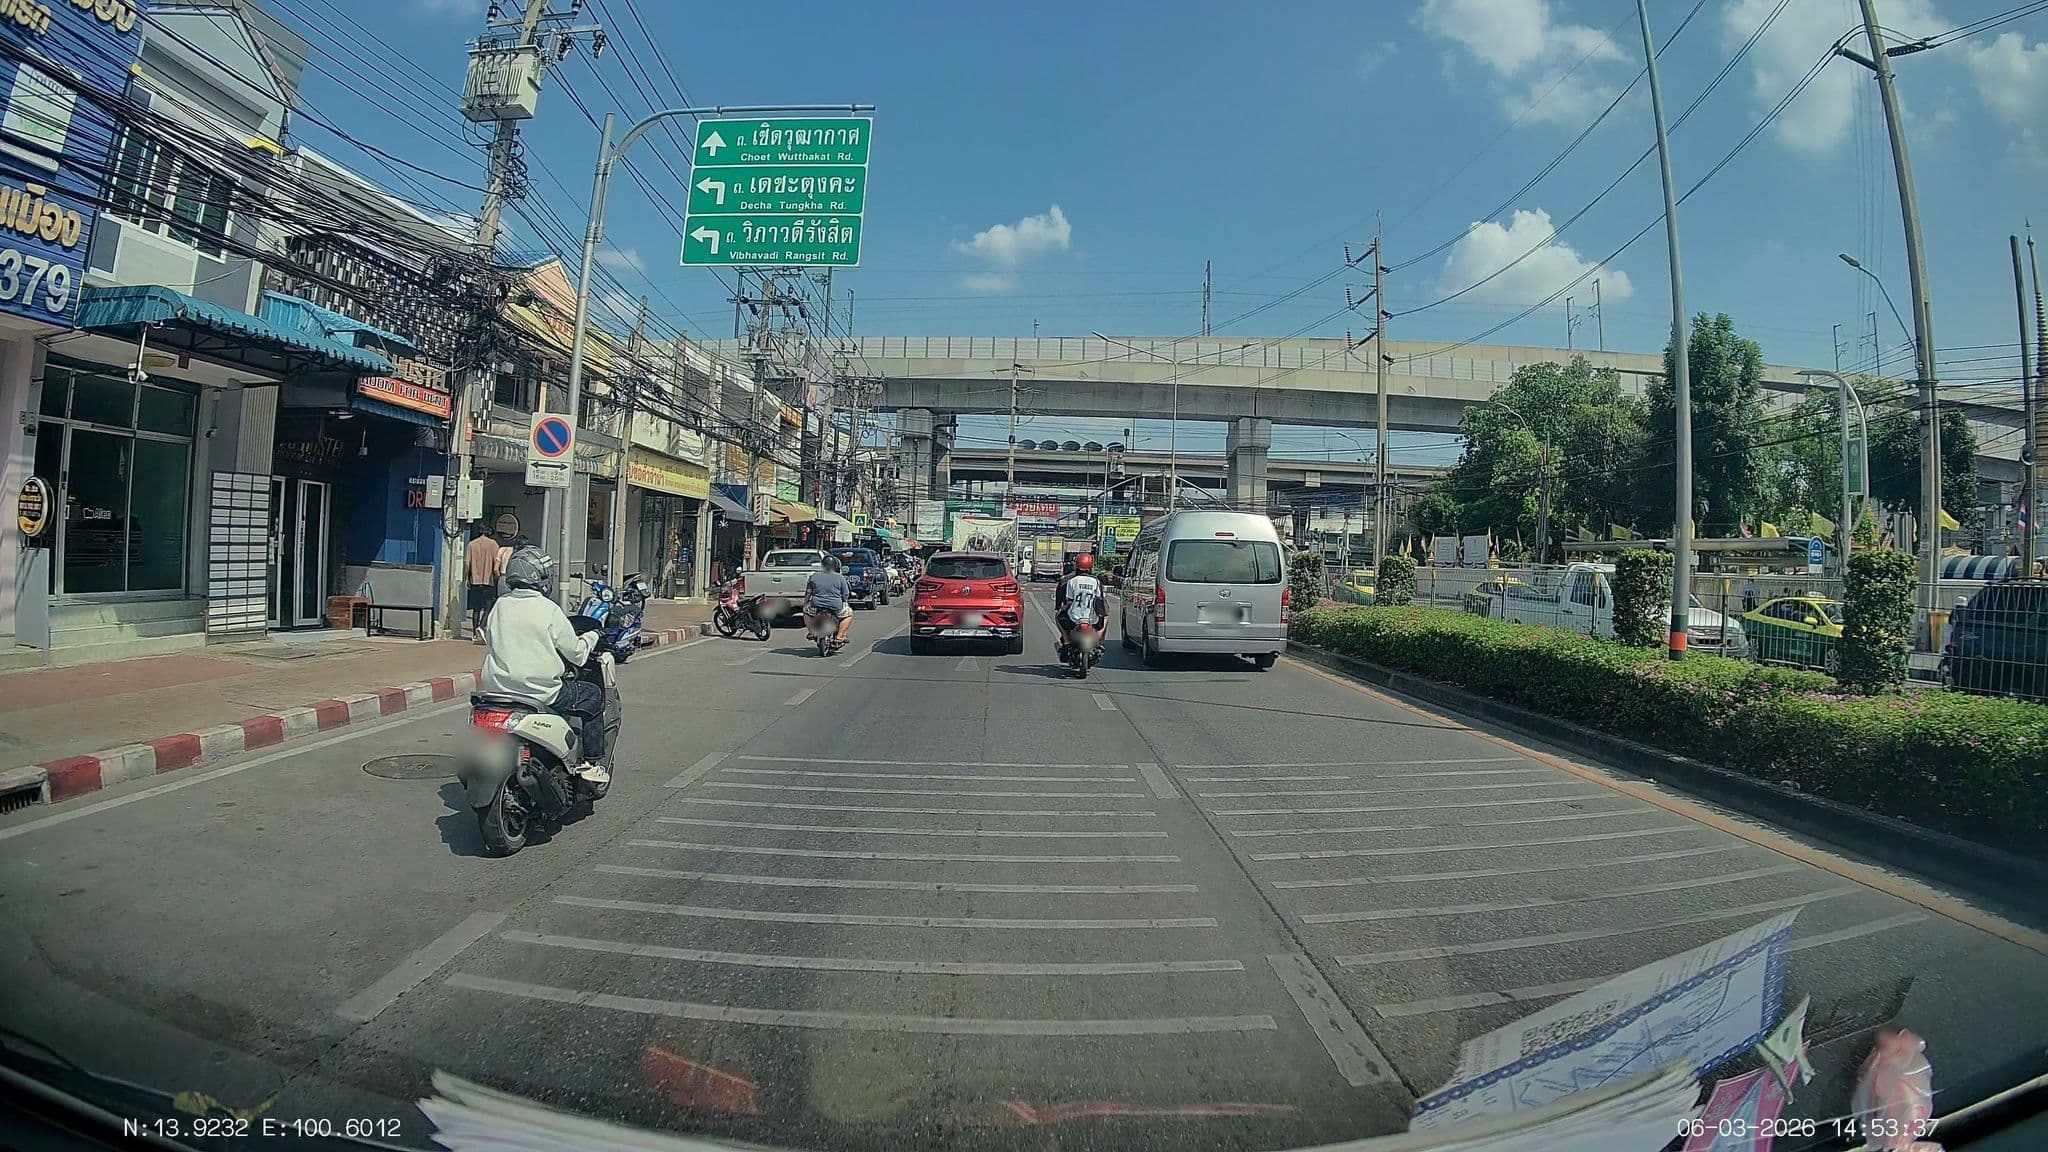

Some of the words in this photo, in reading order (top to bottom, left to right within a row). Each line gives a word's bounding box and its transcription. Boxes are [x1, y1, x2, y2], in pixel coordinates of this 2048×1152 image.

[752, 122, 860, 151] เชิดวุฒากาศ
[740, 153, 771, 161] Choet
[778, 152, 830, 161] Wutthakat
[837, 153, 854, 161] Rd.
[750, 176, 856, 199] เดชะตุงคะ
[740, 201, 772, 210] Decha
[779, 201, 823, 212] Tungkha
[830, 201, 847, 210] Rd.
[742, 218, 853, 244] วิภาวดีรังสิต
[729, 251, 779, 260] Vibhavadi
[785, 251, 826, 262] Rangsit
[832, 251, 849, 260] Rd.
[392, 353, 450, 394] HOSTEL
[399, 384, 420, 401] FOR
[1075, 592, 1094, 609] 47
